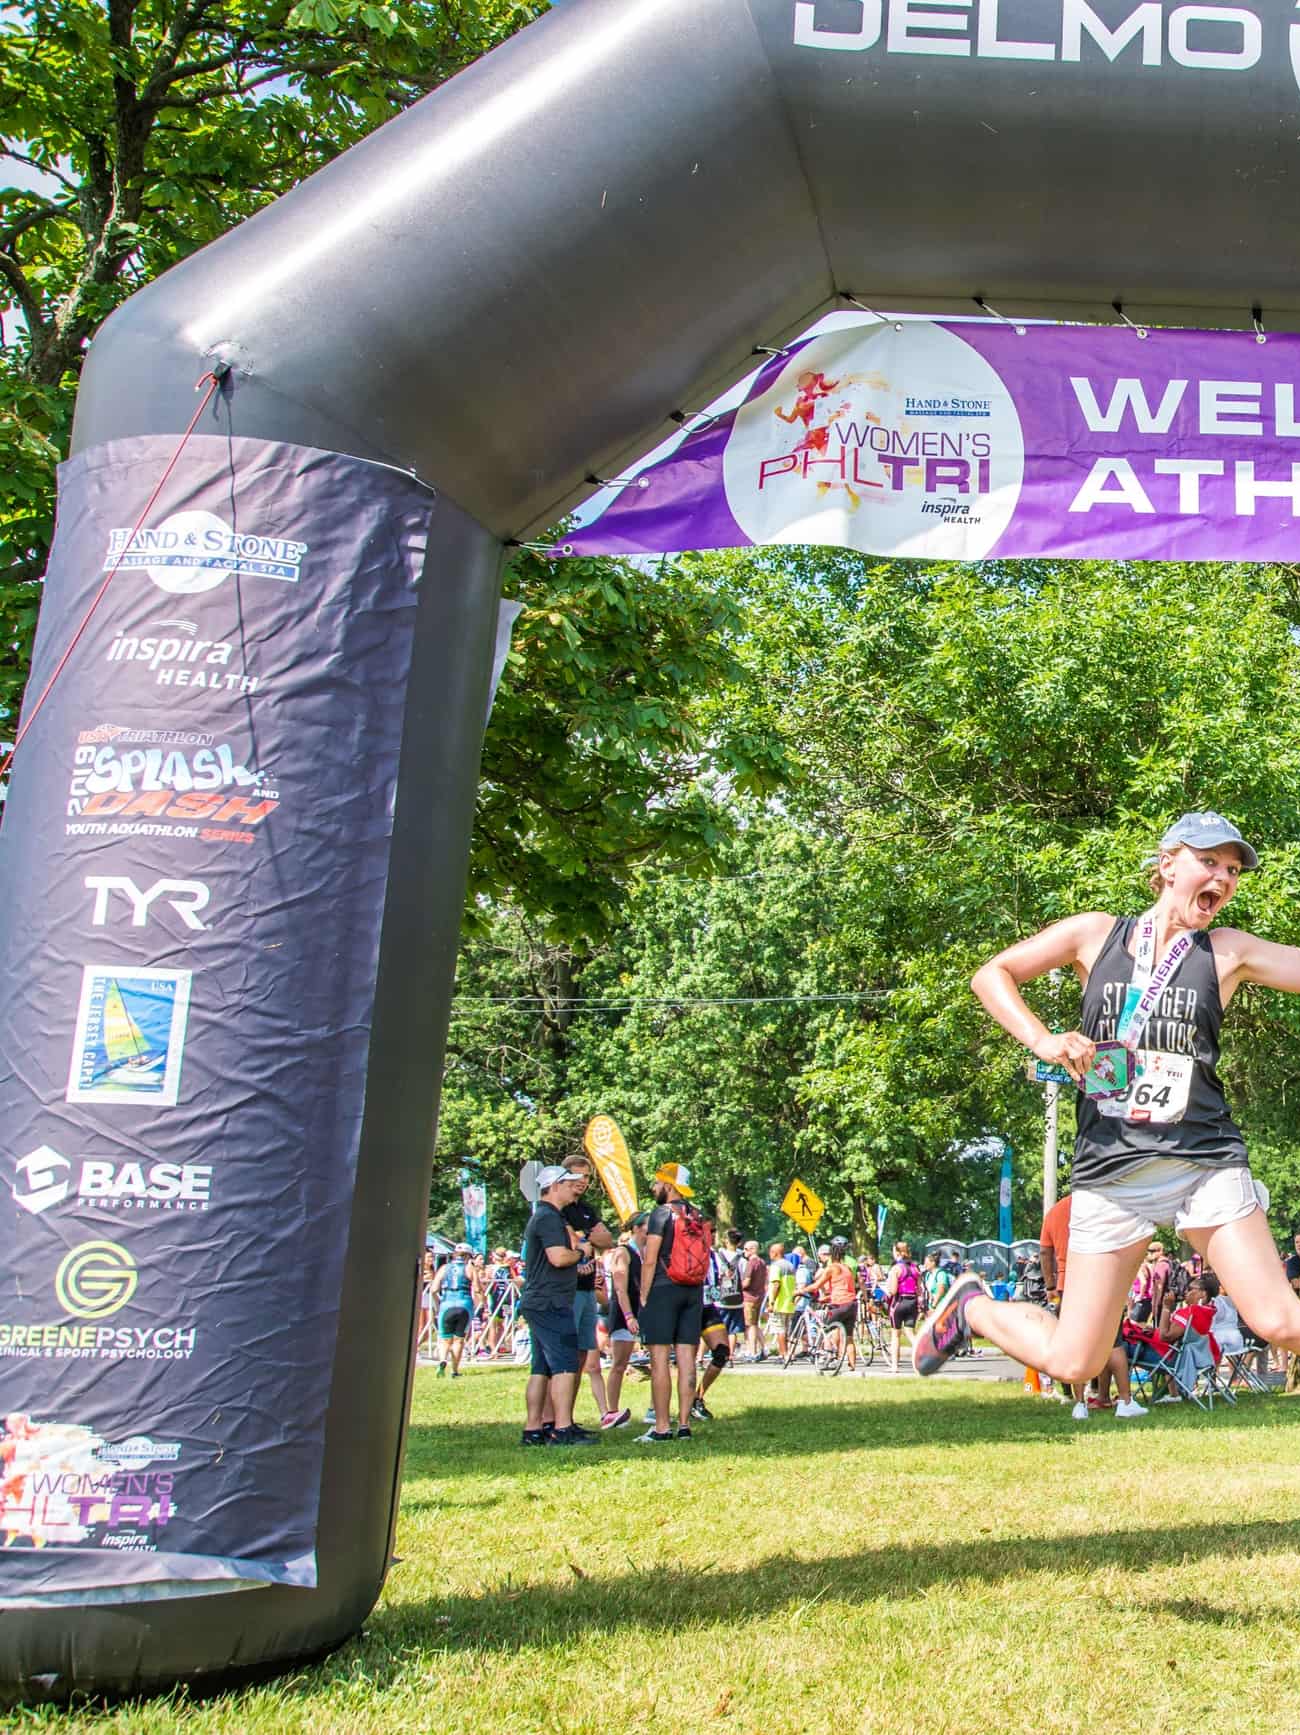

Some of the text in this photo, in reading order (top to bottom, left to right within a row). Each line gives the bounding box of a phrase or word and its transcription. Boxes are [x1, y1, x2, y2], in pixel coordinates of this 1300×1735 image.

[794, 0, 1262, 70] DELMO
[905, 398, 941, 408] HAND
[951, 398, 991, 409] STONE
[836, 423, 991, 457] WOMEN'S
[921, 500, 970, 517] inspira
[944, 516, 981, 525] HEALTH
[110, 529, 302, 561] HAND & STONE
[172, 556, 200, 567] AND
[260, 565, 286, 575] SPA
[107, 630, 233, 670] inspira
[156, 669, 259, 693] HEALTH
[85, 743, 262, 794] SPLASH
[252, 788, 280, 799] AND
[81, 790, 281, 825] DASH
[66, 822, 107, 836] YOUTH
[108, 823, 199, 838] AQUATHLON
[84, 876, 210, 930] TYR
[1141, 937, 1189, 1012] FINISHER
[1157, 1021, 1198, 1056] LOOK
[79, 1161, 213, 1200] BASE
[78, 1198, 209, 1210] PERFORMANCE
[0, 1325, 197, 1349] GREENEPSYCH
[56, 1349, 97, 1358] SPORT
[101, 1349, 193, 1360] PSYCHOLOGY
[32, 1471, 175, 1496] WOMEN'S
[102, 1532, 148, 1548] inspira
